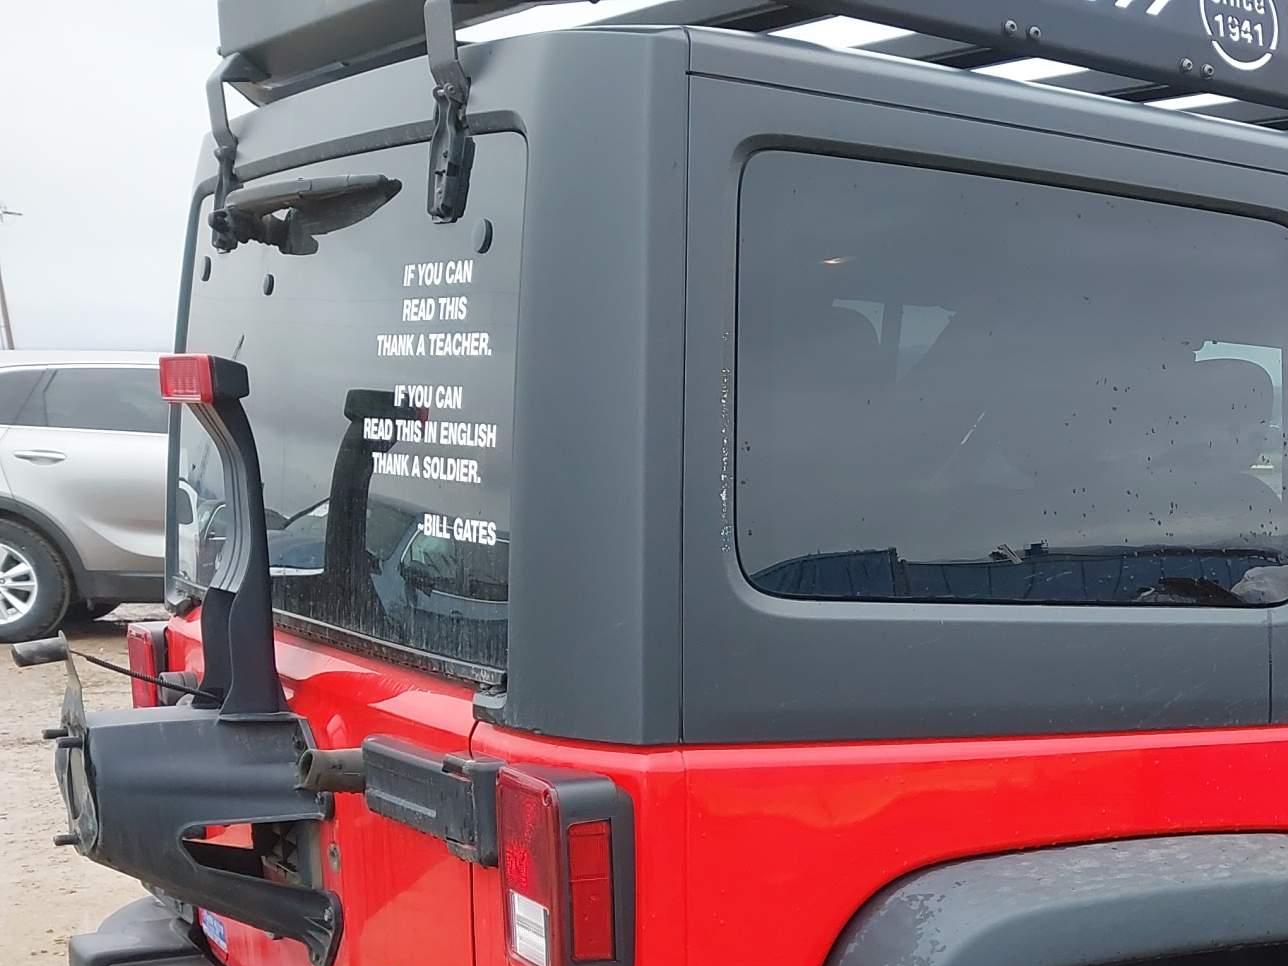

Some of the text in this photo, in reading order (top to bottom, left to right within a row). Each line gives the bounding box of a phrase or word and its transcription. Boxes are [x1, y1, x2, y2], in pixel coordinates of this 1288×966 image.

[1214, 14, 1263, 46] 1941
[403, 260, 473, 286] IF YOU CAN
[402, 297, 467, 321] READ THIS
[377, 333, 492, 356] THANK A TEACHER.
[394, 385, 463, 409] IF YOU CAN
[363, 418, 497, 448] READ THIS IN ENGLISH
[372, 452, 481, 483] THANK A SOLDIER.
[453, 518, 497, 546] GATES
